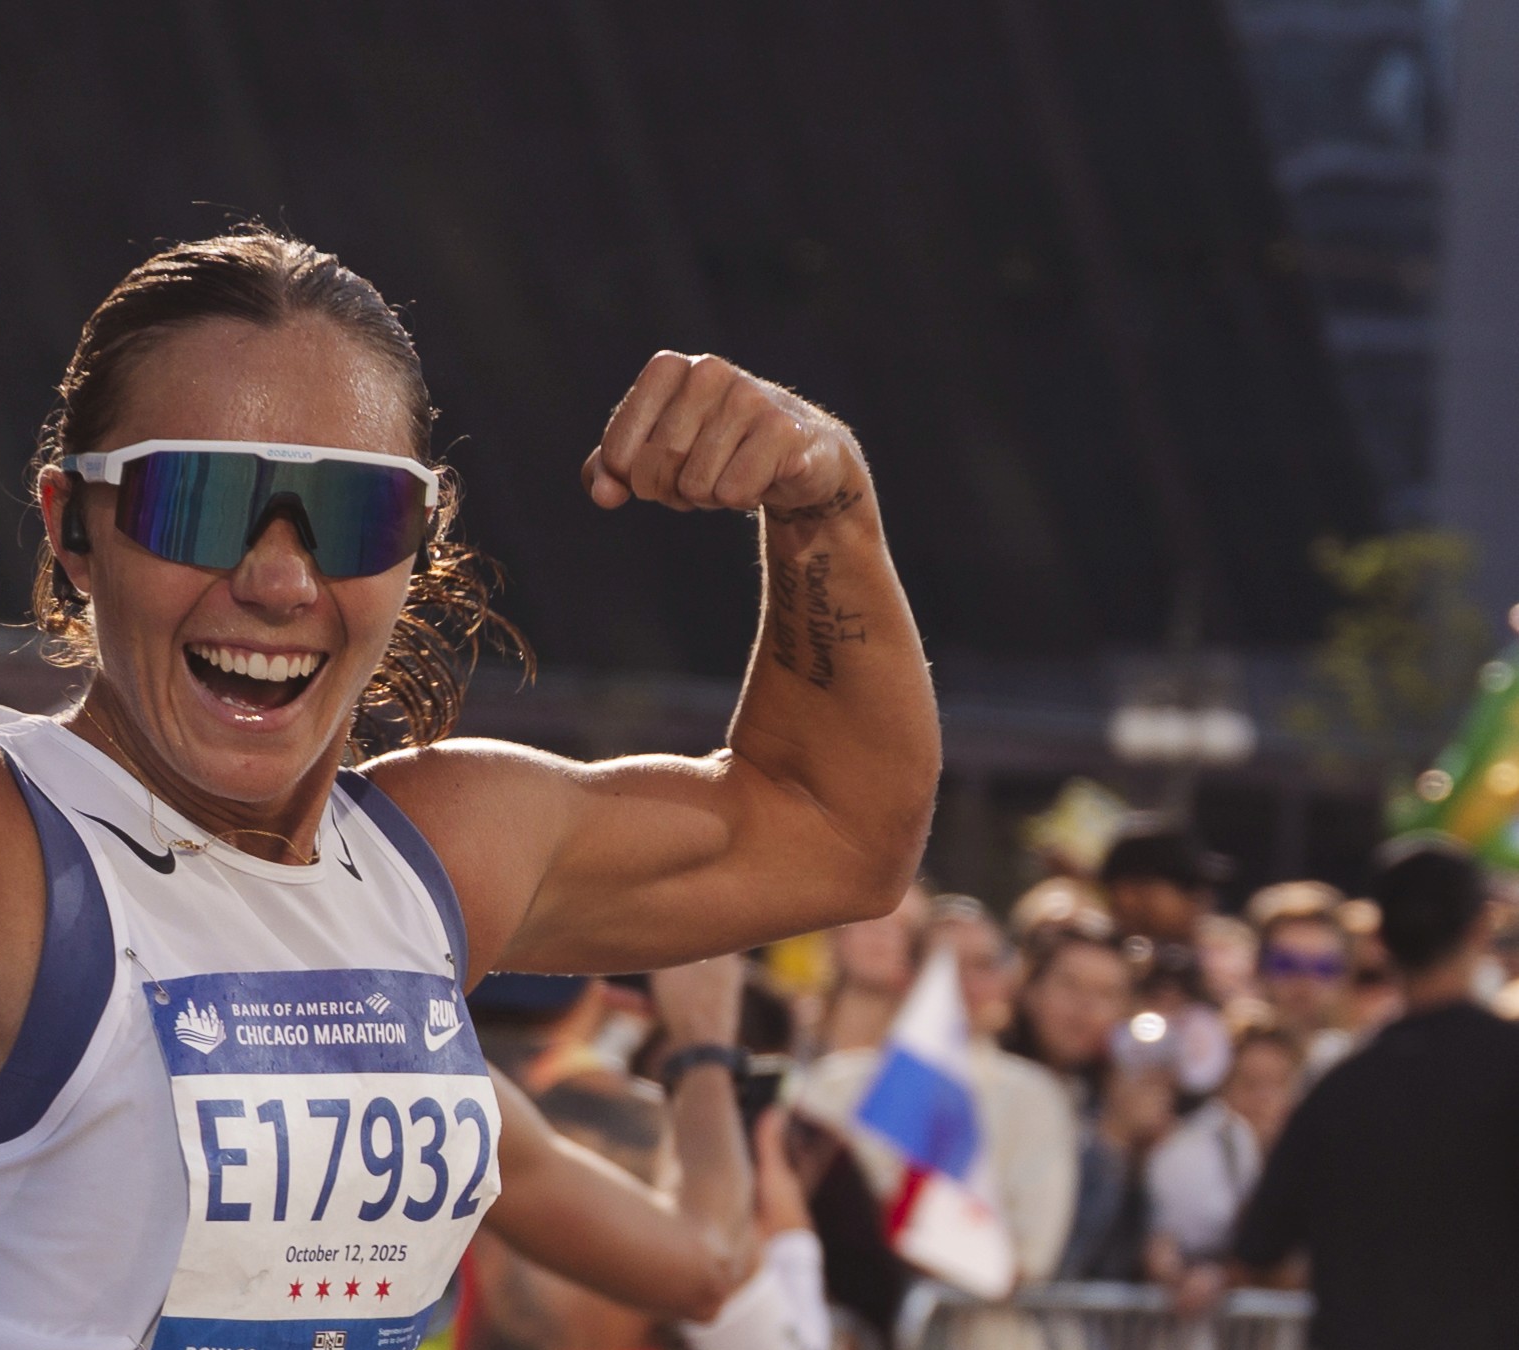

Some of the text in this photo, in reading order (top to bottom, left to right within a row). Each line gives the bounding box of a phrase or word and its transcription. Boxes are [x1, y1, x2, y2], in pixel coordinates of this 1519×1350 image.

[834, 606, 866, 645] IT
[231, 1001, 365, 1017] BANK OF AMERICA
[429, 999, 459, 1028] RUN
[235, 1023, 406, 1046] CHICAGO MARATHON
[195, 1096, 491, 1223] E17932
[285, 1244, 408, 1265] October 12, 2025
